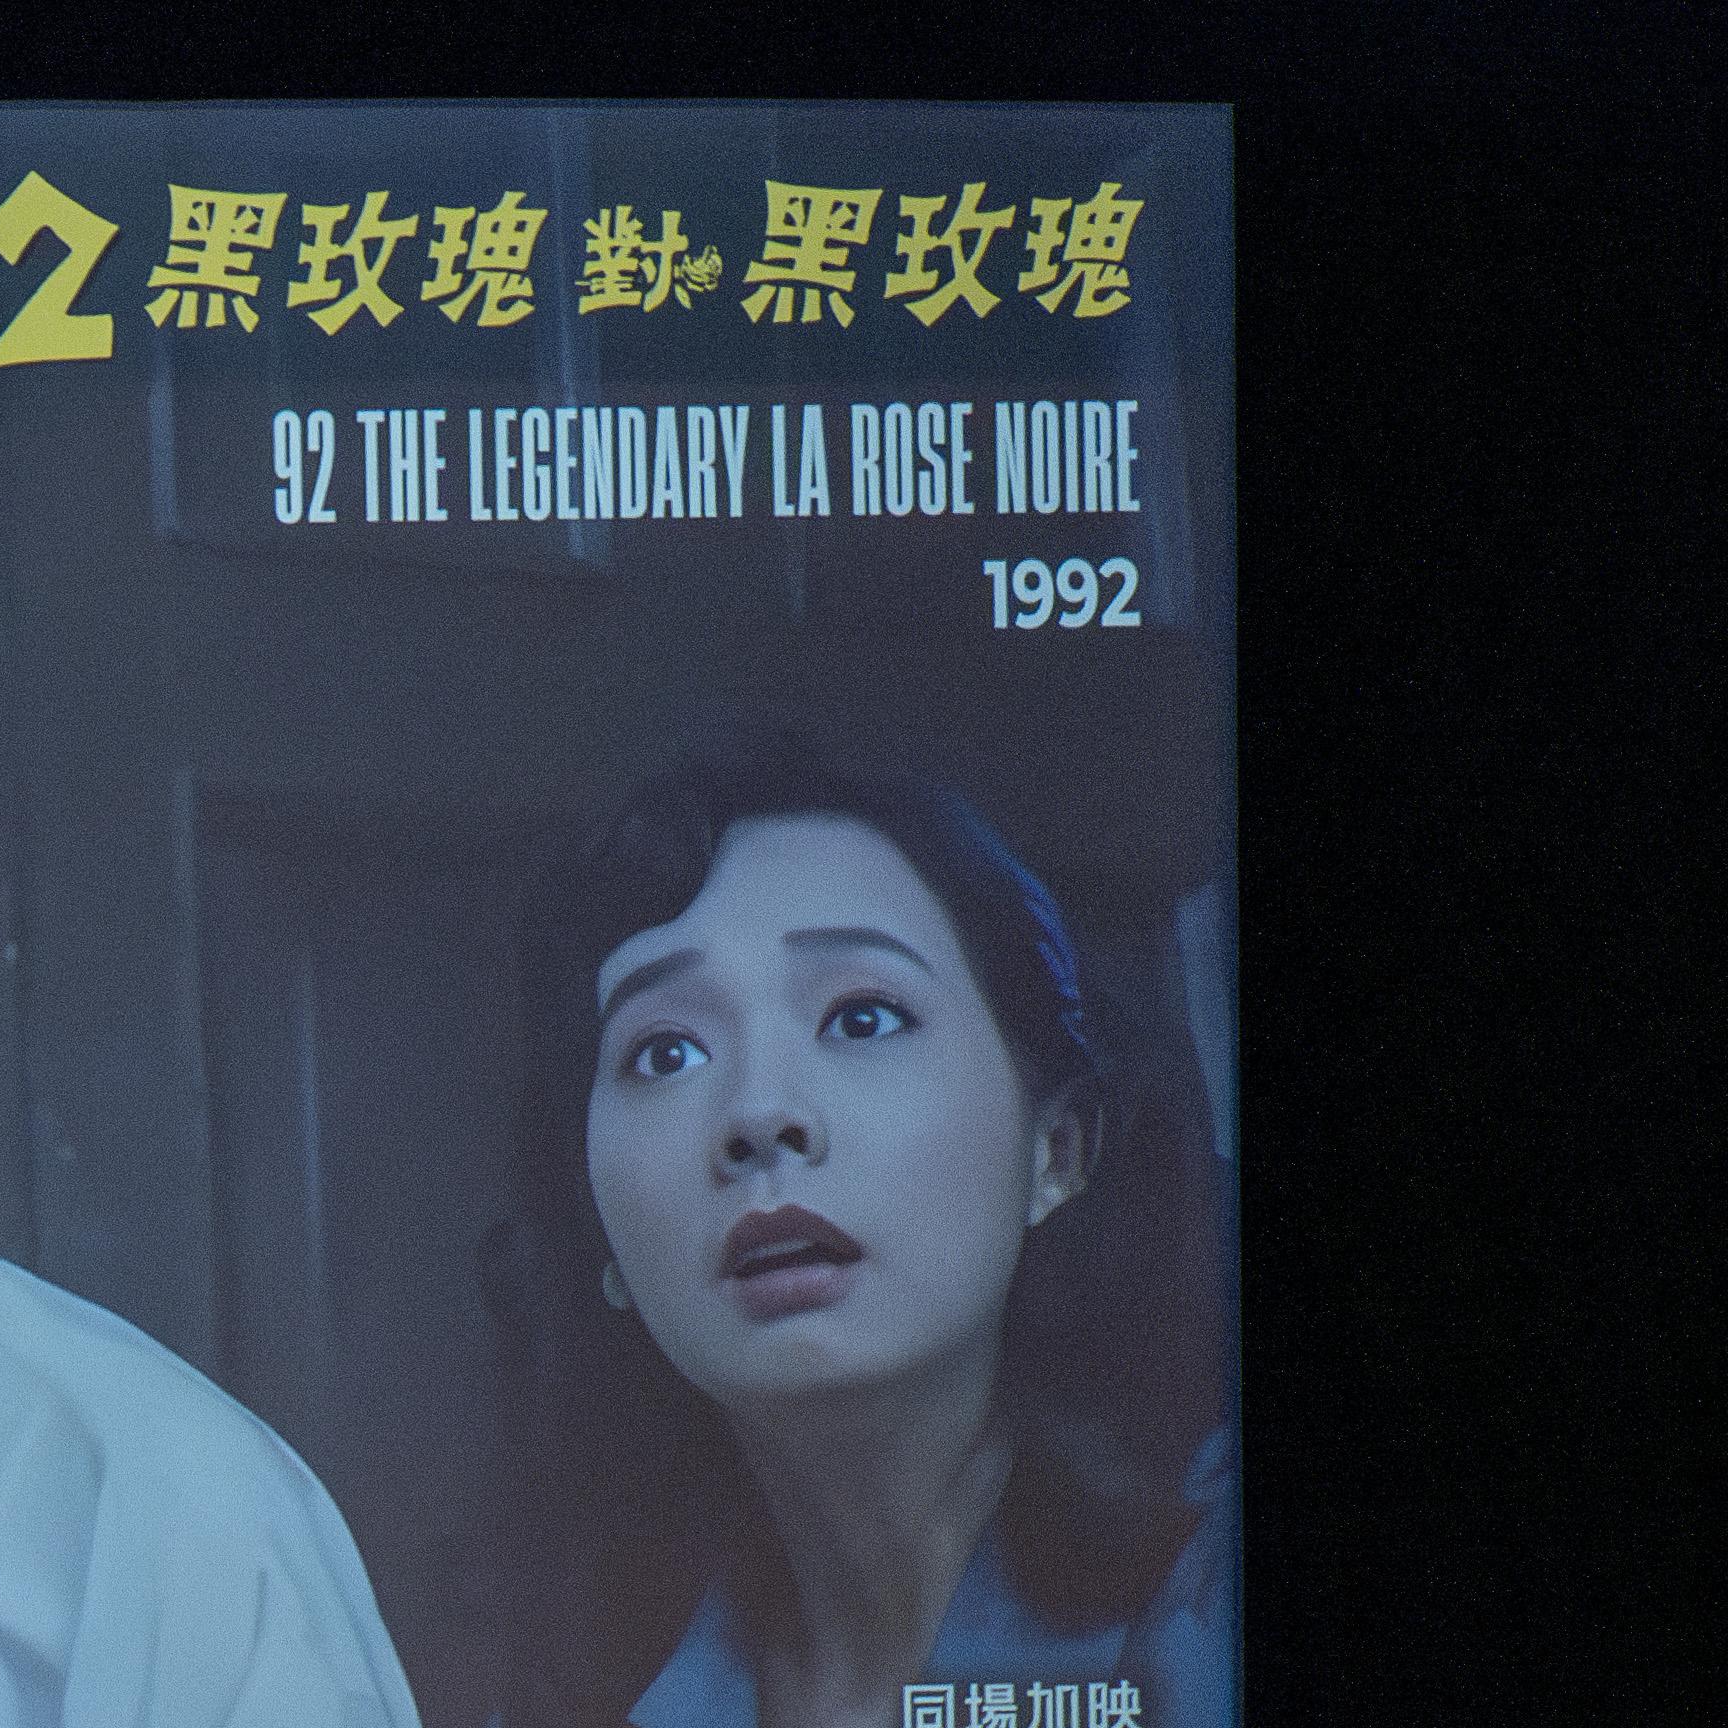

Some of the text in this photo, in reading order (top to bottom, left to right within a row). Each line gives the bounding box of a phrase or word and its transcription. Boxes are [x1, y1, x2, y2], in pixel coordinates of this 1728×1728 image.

[272, 400, 1141, 524] 92 THE LEGENDARY LA ROSE NOIRE
[983, 556, 1142, 629] 1992
